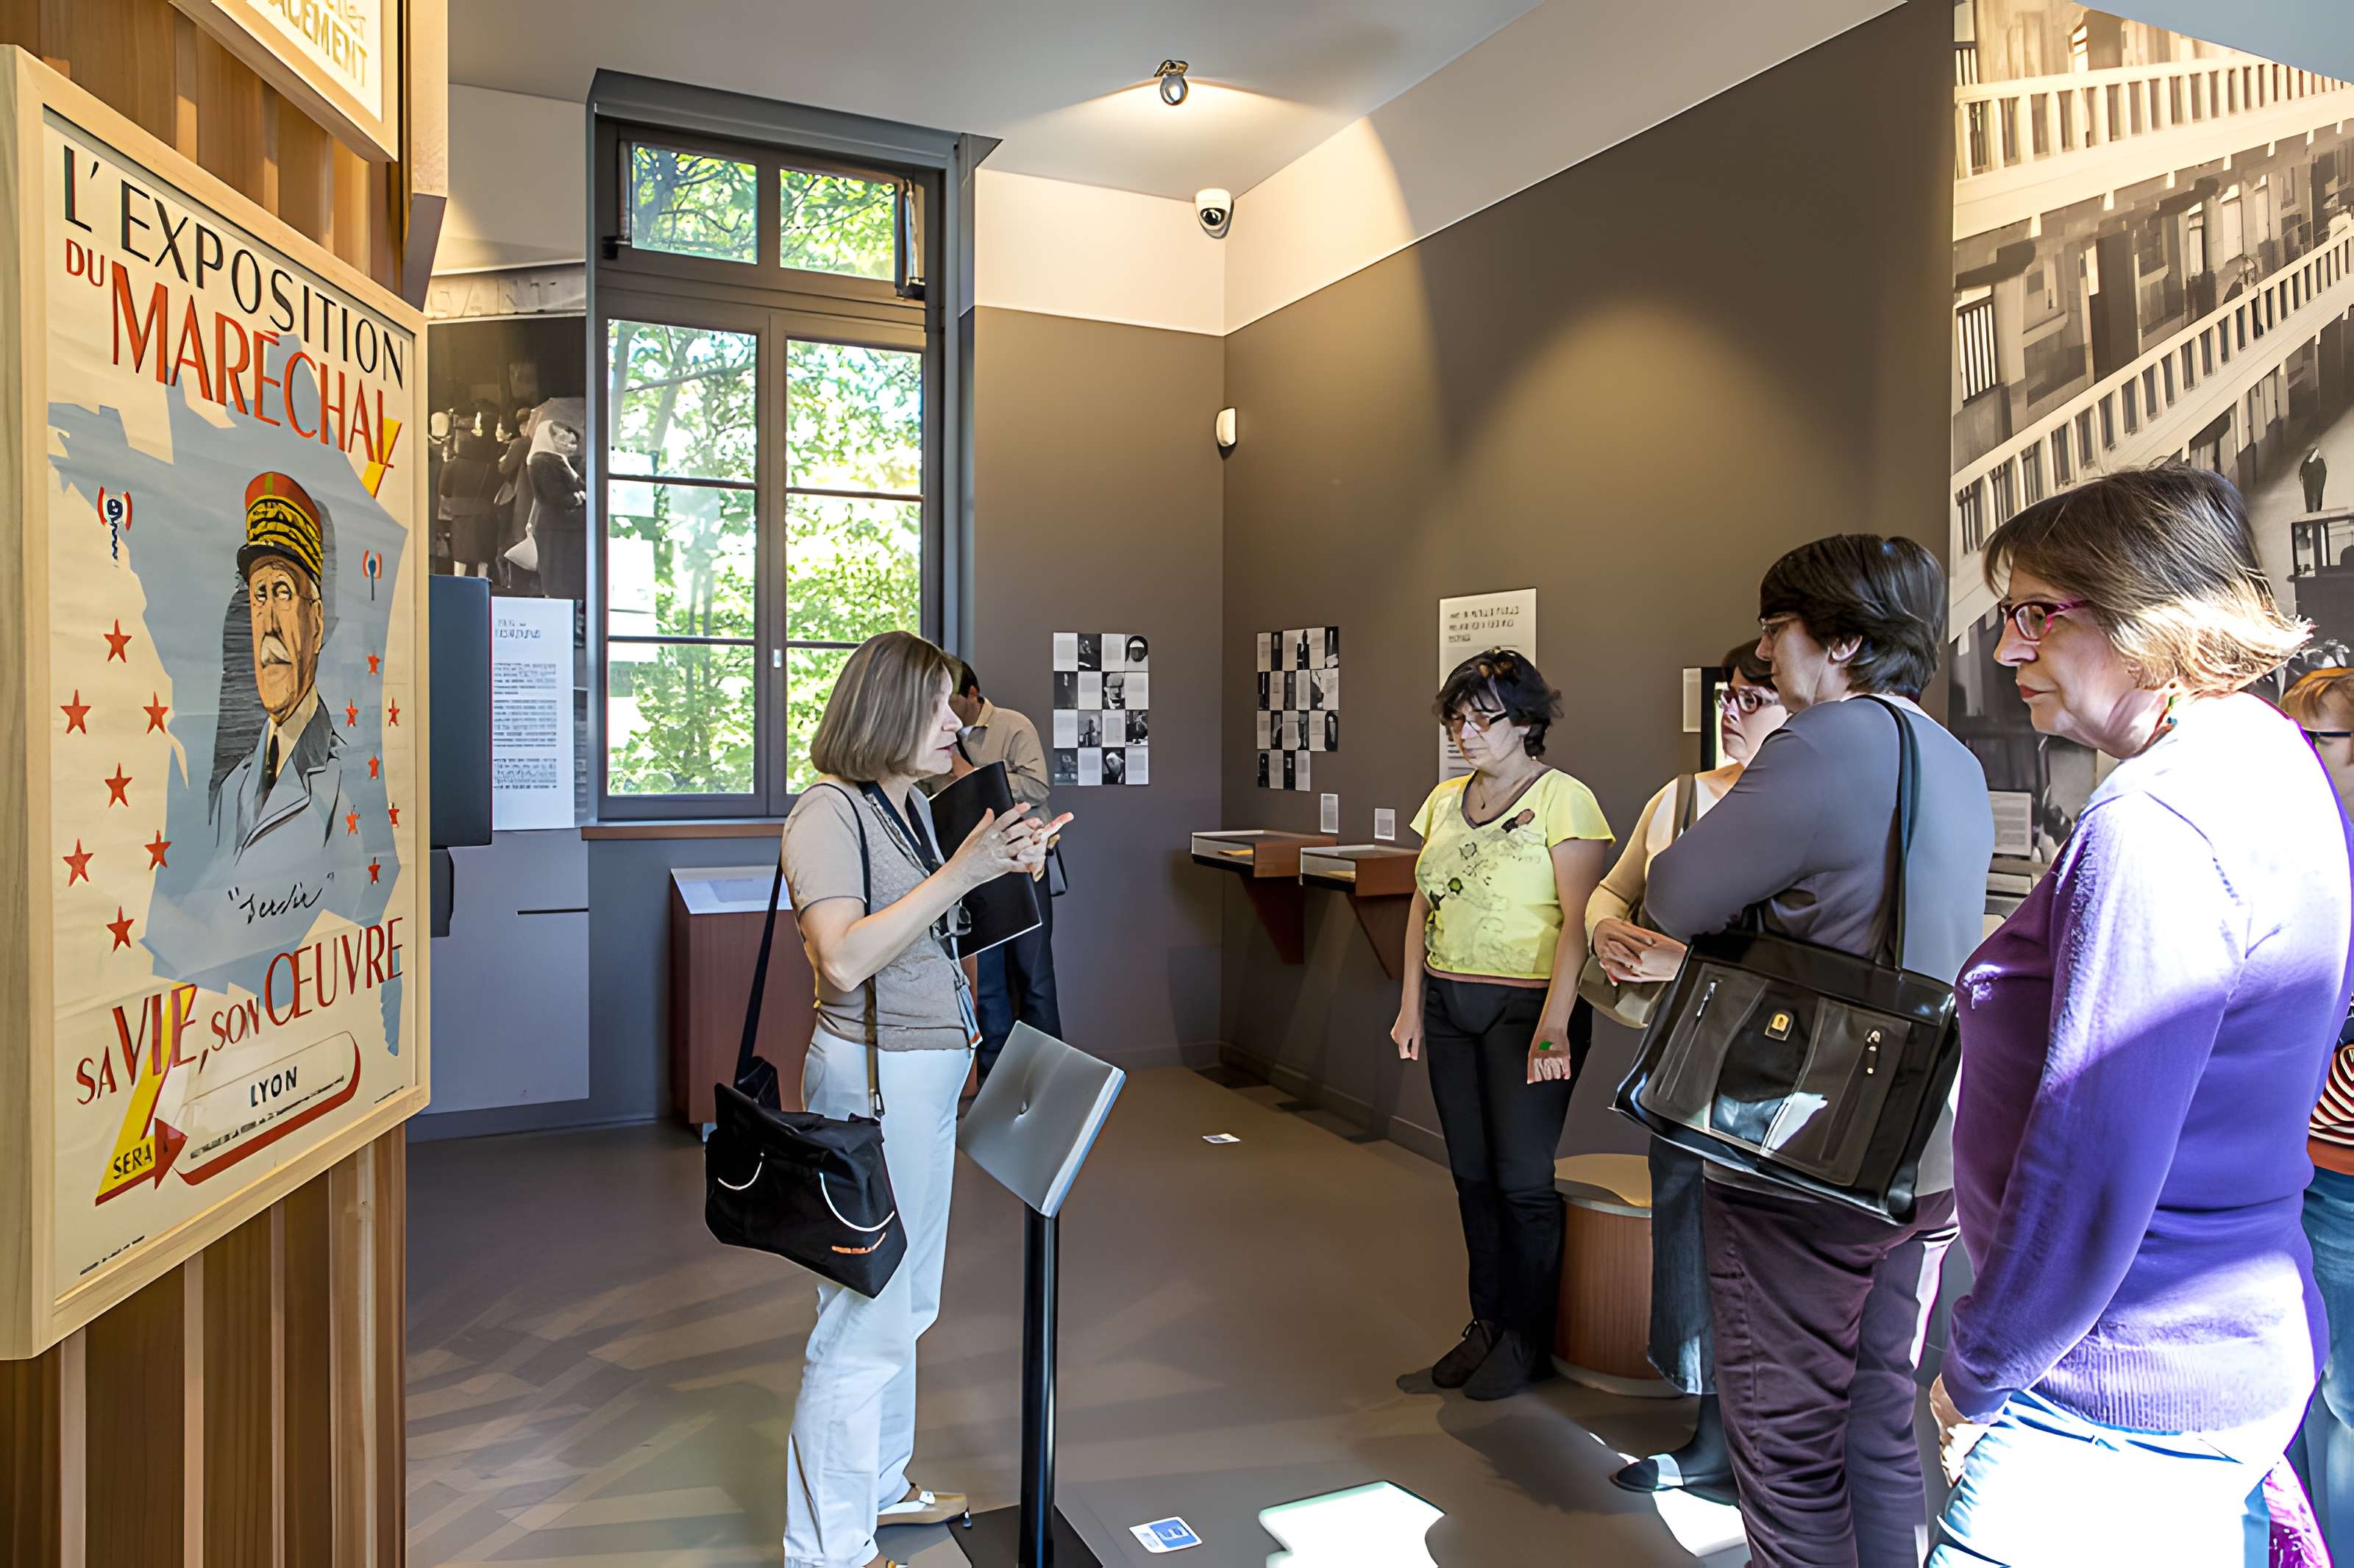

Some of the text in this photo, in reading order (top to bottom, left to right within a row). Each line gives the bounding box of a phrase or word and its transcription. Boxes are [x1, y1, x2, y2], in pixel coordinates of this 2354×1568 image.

[65, 238, 105, 288] DU
[111, 260, 394, 469] MARÉCHAL
[76, 1045, 118, 1105] SA
[210, 997, 260, 1052] SON
[264, 916, 404, 1026] ŒUVRE
[250, 1065, 298, 1108] LYON
[112, 1143, 153, 1180] SERA
